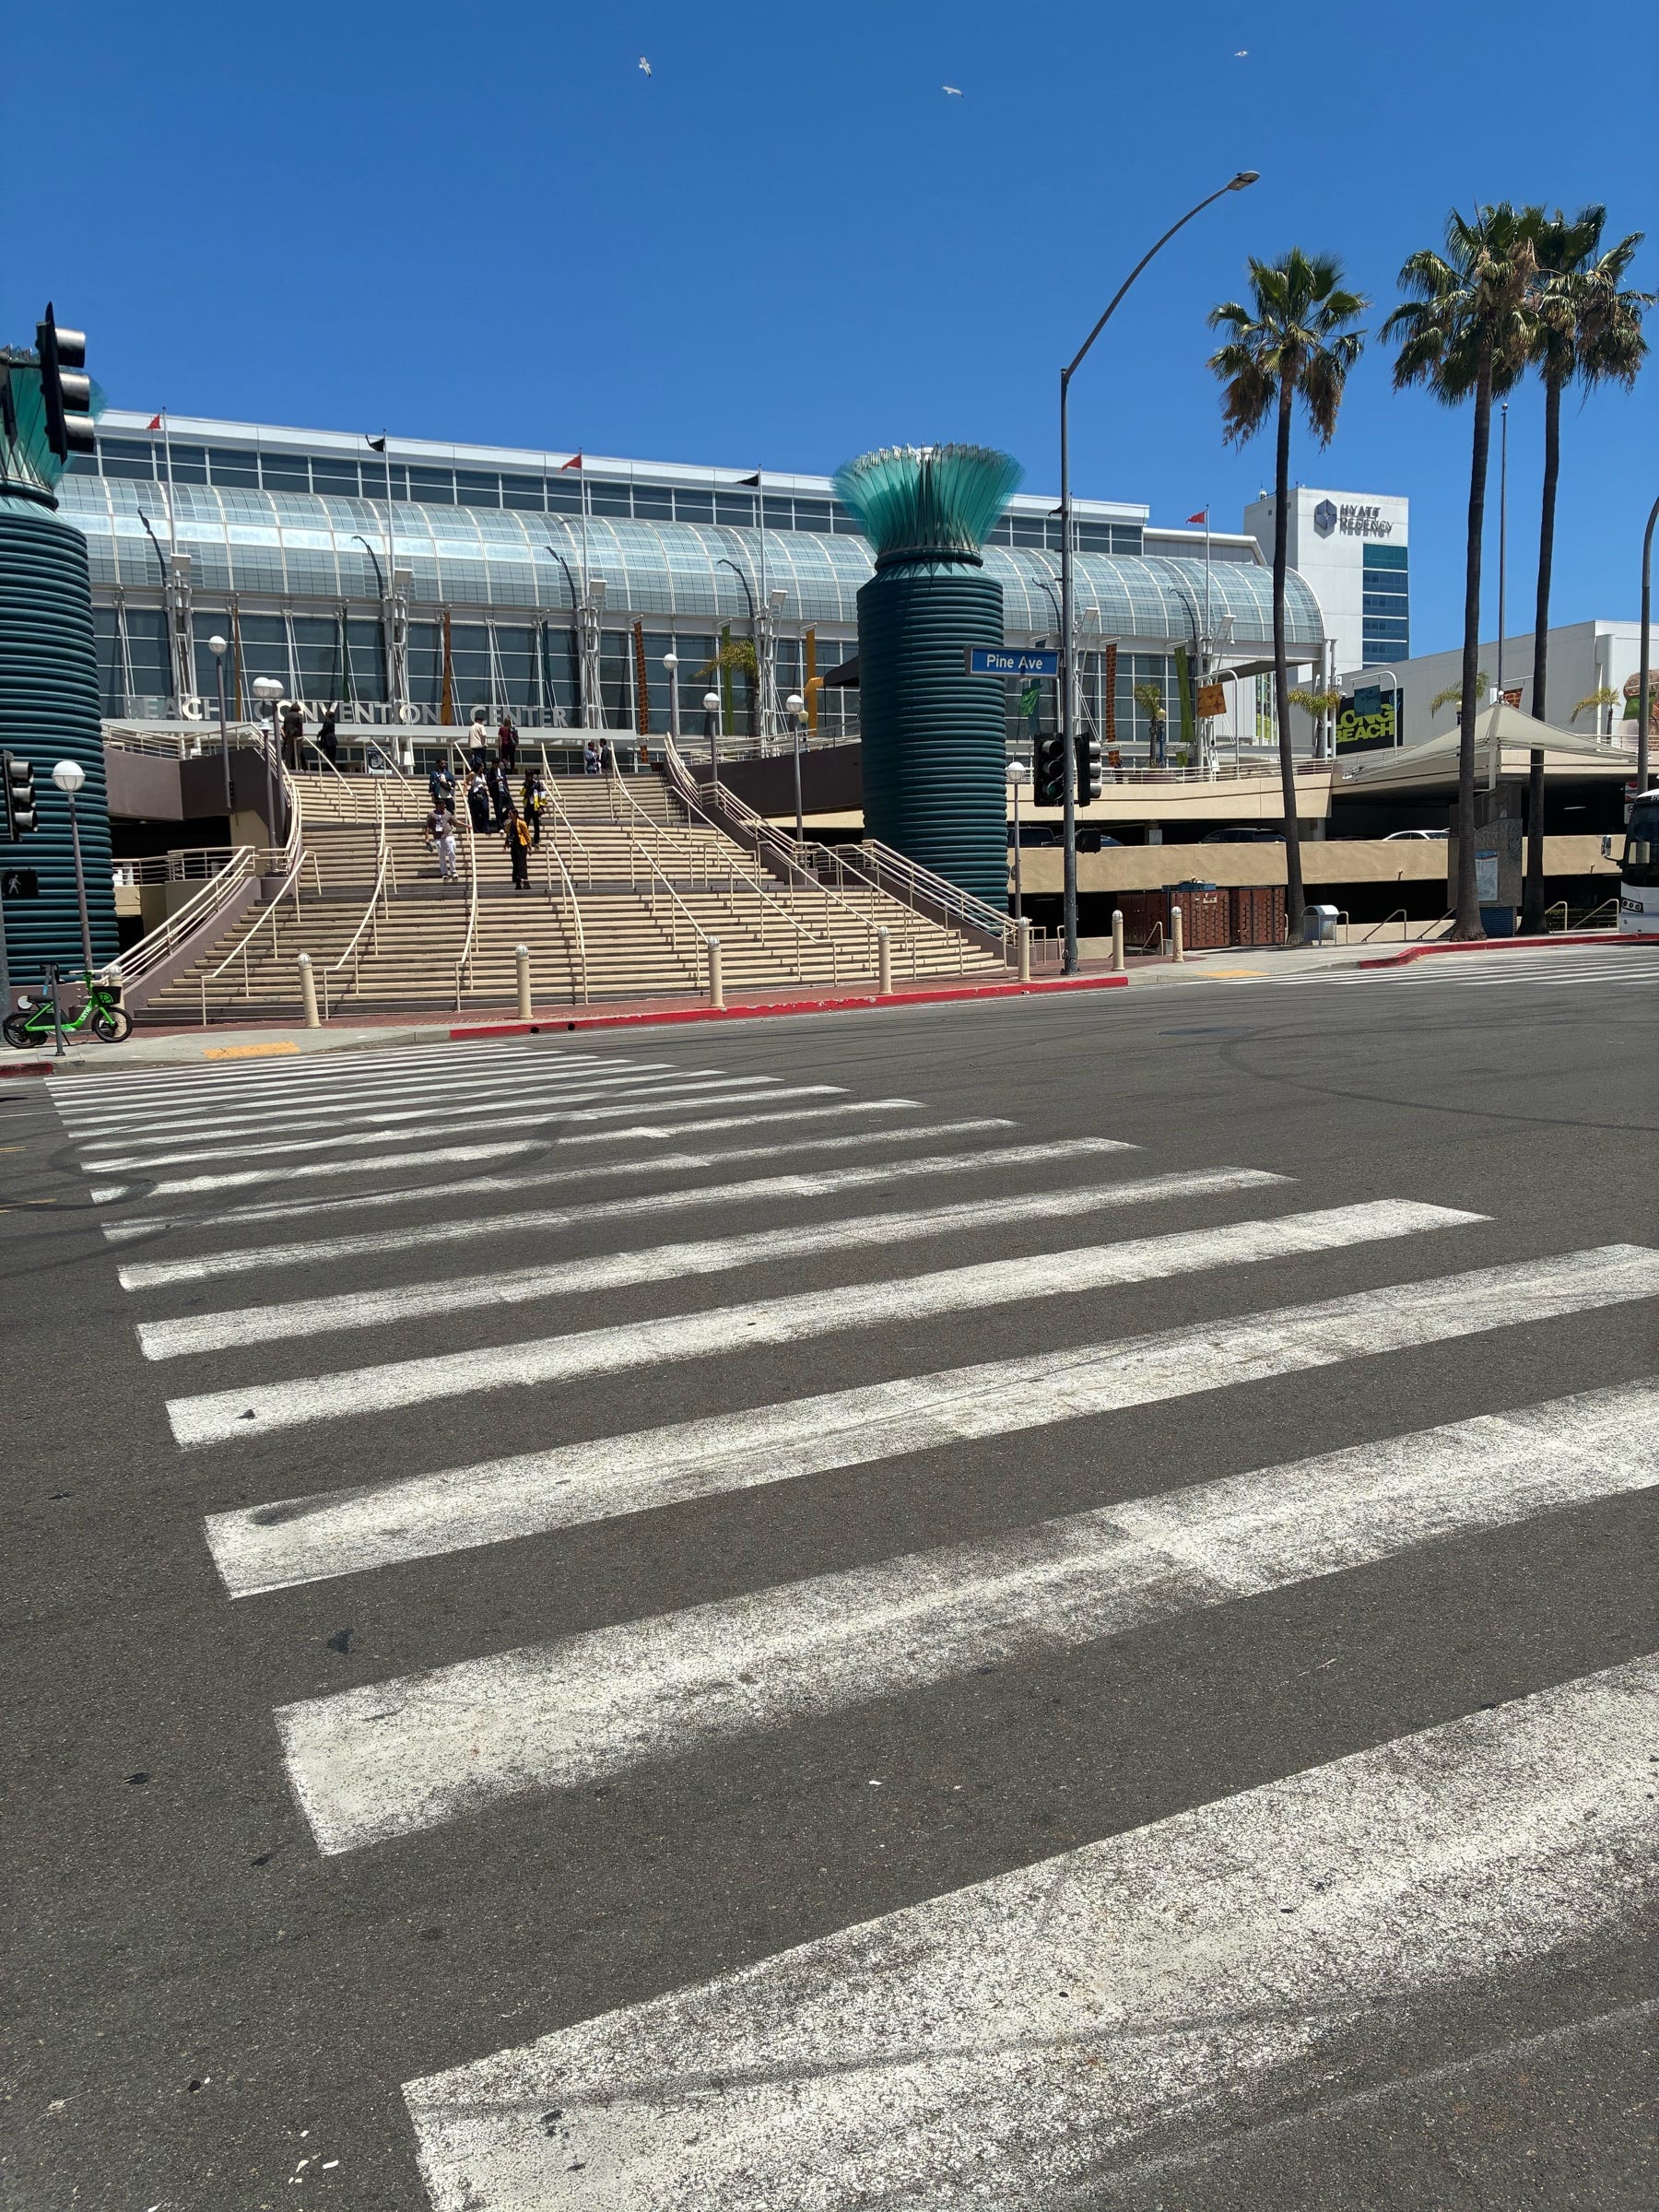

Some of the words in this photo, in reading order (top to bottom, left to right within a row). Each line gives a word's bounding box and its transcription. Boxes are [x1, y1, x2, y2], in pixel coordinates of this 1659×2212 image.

[1340, 504, 1381, 518] HYATT
[1340, 517, 1394, 534] REGENCY
[986, 653, 1014, 668] Pine
[1018, 655, 1043, 670] Ave
[470, 706, 568, 727] CENTER
[1336, 703, 1394, 730] OG
